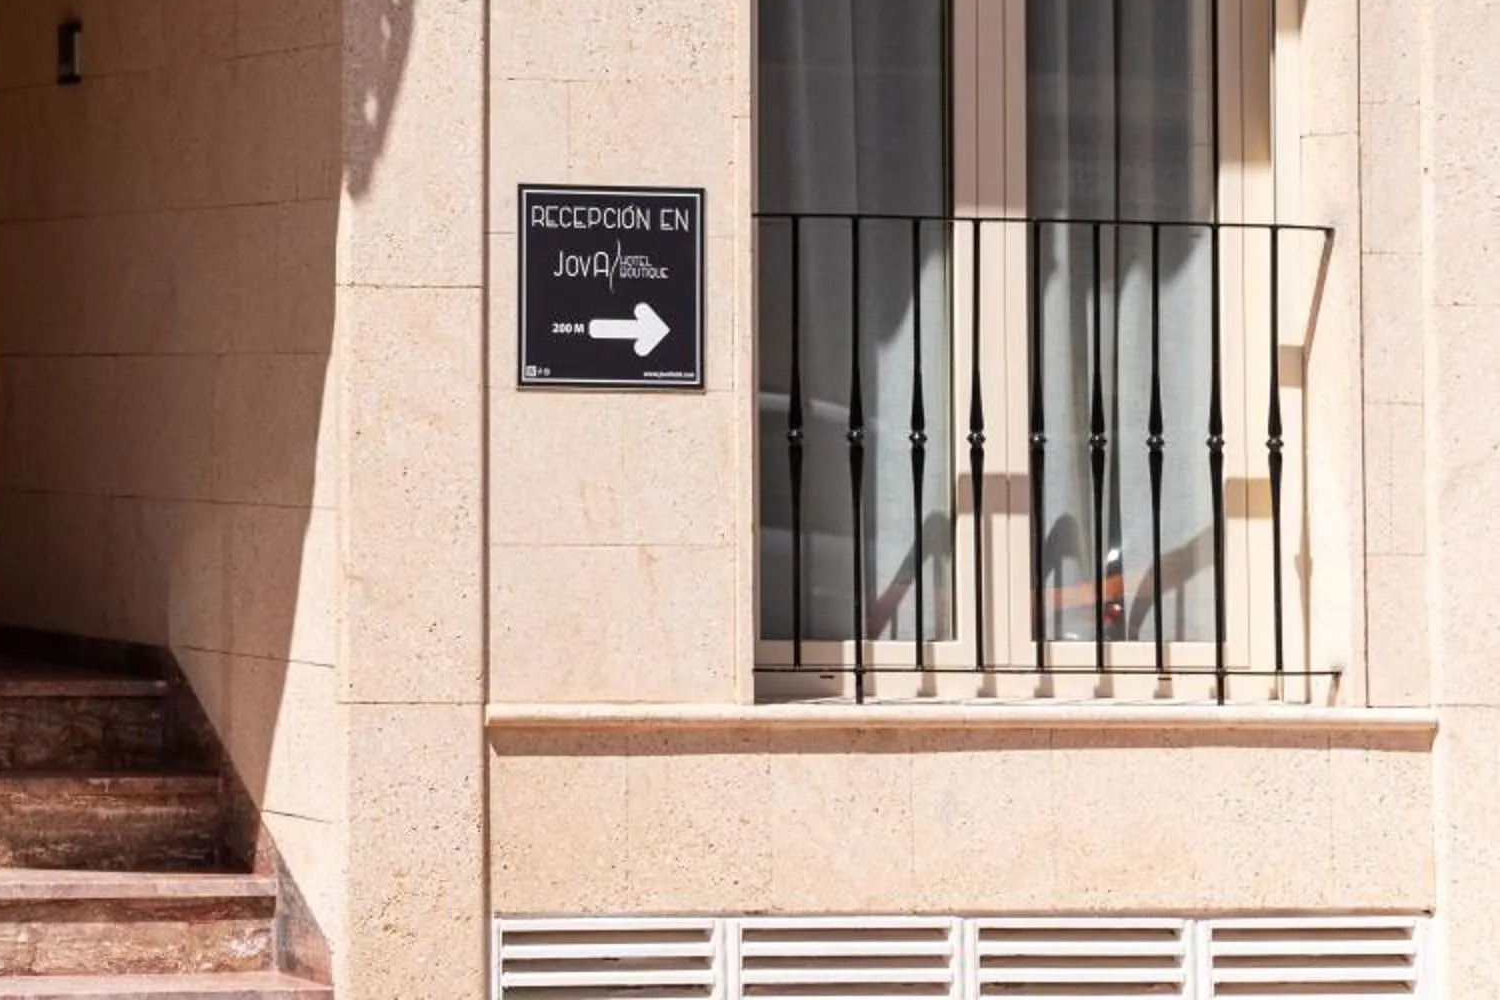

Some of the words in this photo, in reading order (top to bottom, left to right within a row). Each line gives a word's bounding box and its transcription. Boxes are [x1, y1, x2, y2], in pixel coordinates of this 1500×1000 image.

[531, 204, 651, 231] RECEPCIÓN
[660, 208, 690, 232] EN
[620, 256, 653, 267] HOTEL
[620, 267, 669, 279] BOUTIQUE
[551, 322, 573, 334] 200
[573, 322, 585, 334] M
